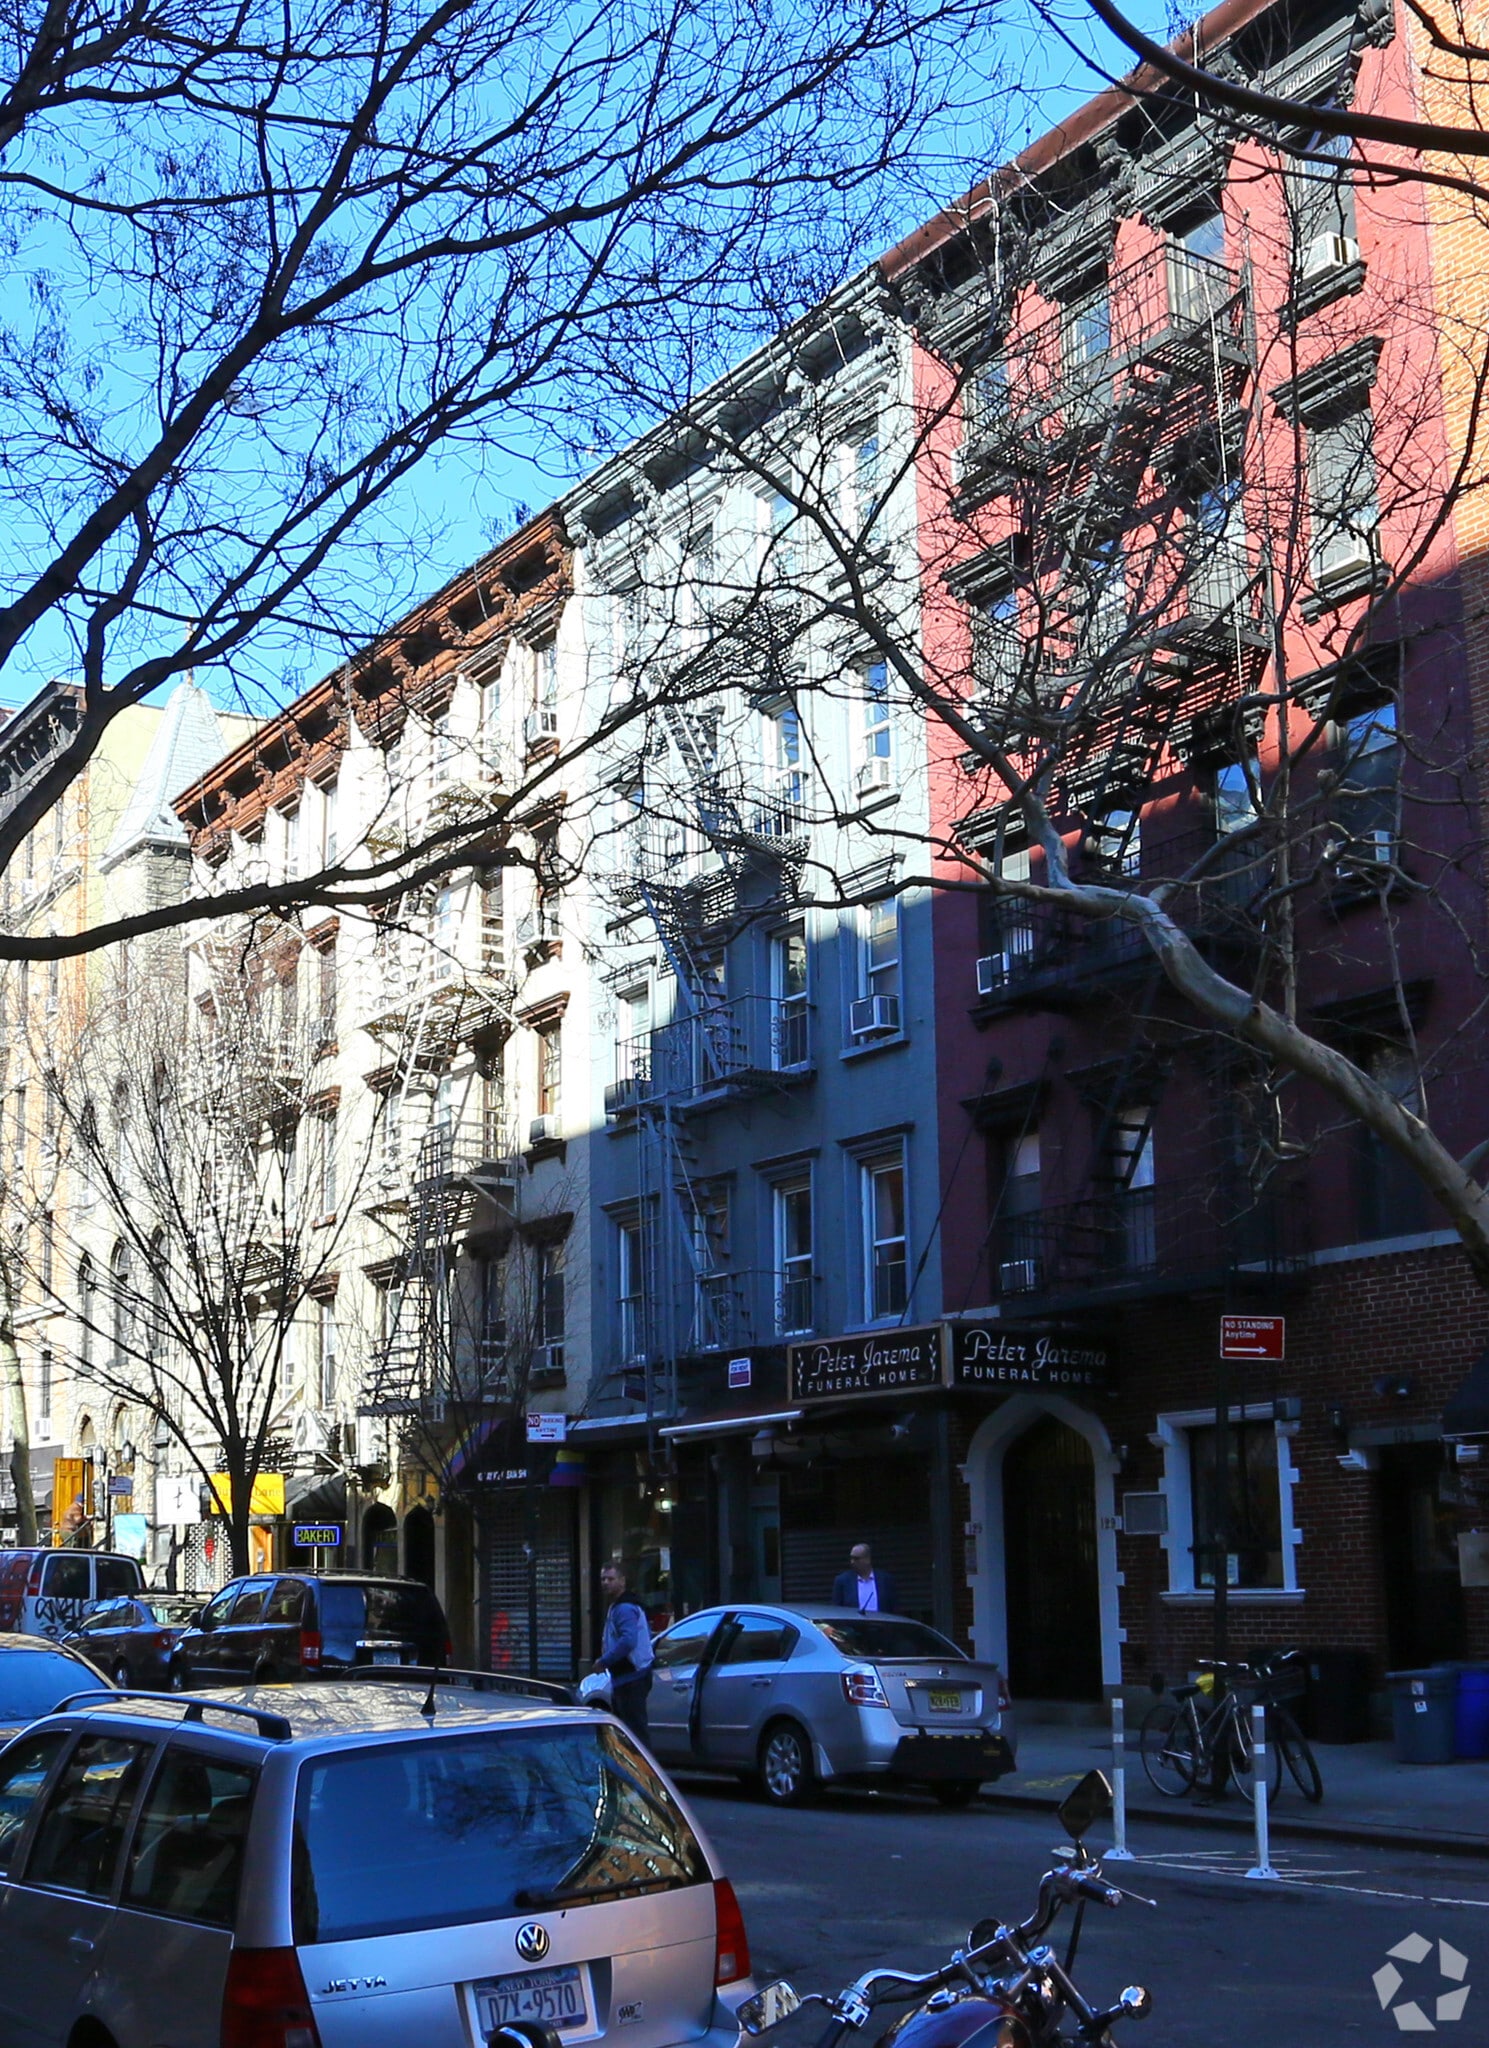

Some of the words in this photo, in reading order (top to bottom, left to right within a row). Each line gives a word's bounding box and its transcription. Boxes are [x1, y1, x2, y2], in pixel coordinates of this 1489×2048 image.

[1225, 1321, 1236, 1329] NO
[1238, 1321, 1274, 1330] STANDING
[1225, 1331, 1256, 1340] Anytime
[811, 1345, 856, 1377] Peter
[860, 1340, 920, 1375] Jarema
[963, 1329, 1027, 1361] Peter
[1031, 1336, 1108, 1370] Jarema
[808, 1376, 871, 1392] FUNERAL
[879, 1369, 917, 1384] HOME
[963, 1366, 1040, 1382] FUNERAL
[1050, 1371, 1094, 1385] HOME
[528, 1415, 540, 1427] NO
[298, 1529, 336, 1544] BAKERY
[322, 1976, 387, 1994] JETTA
[503, 1981, 526, 1992] NEW
[528, 1974, 558, 1990] YORK
